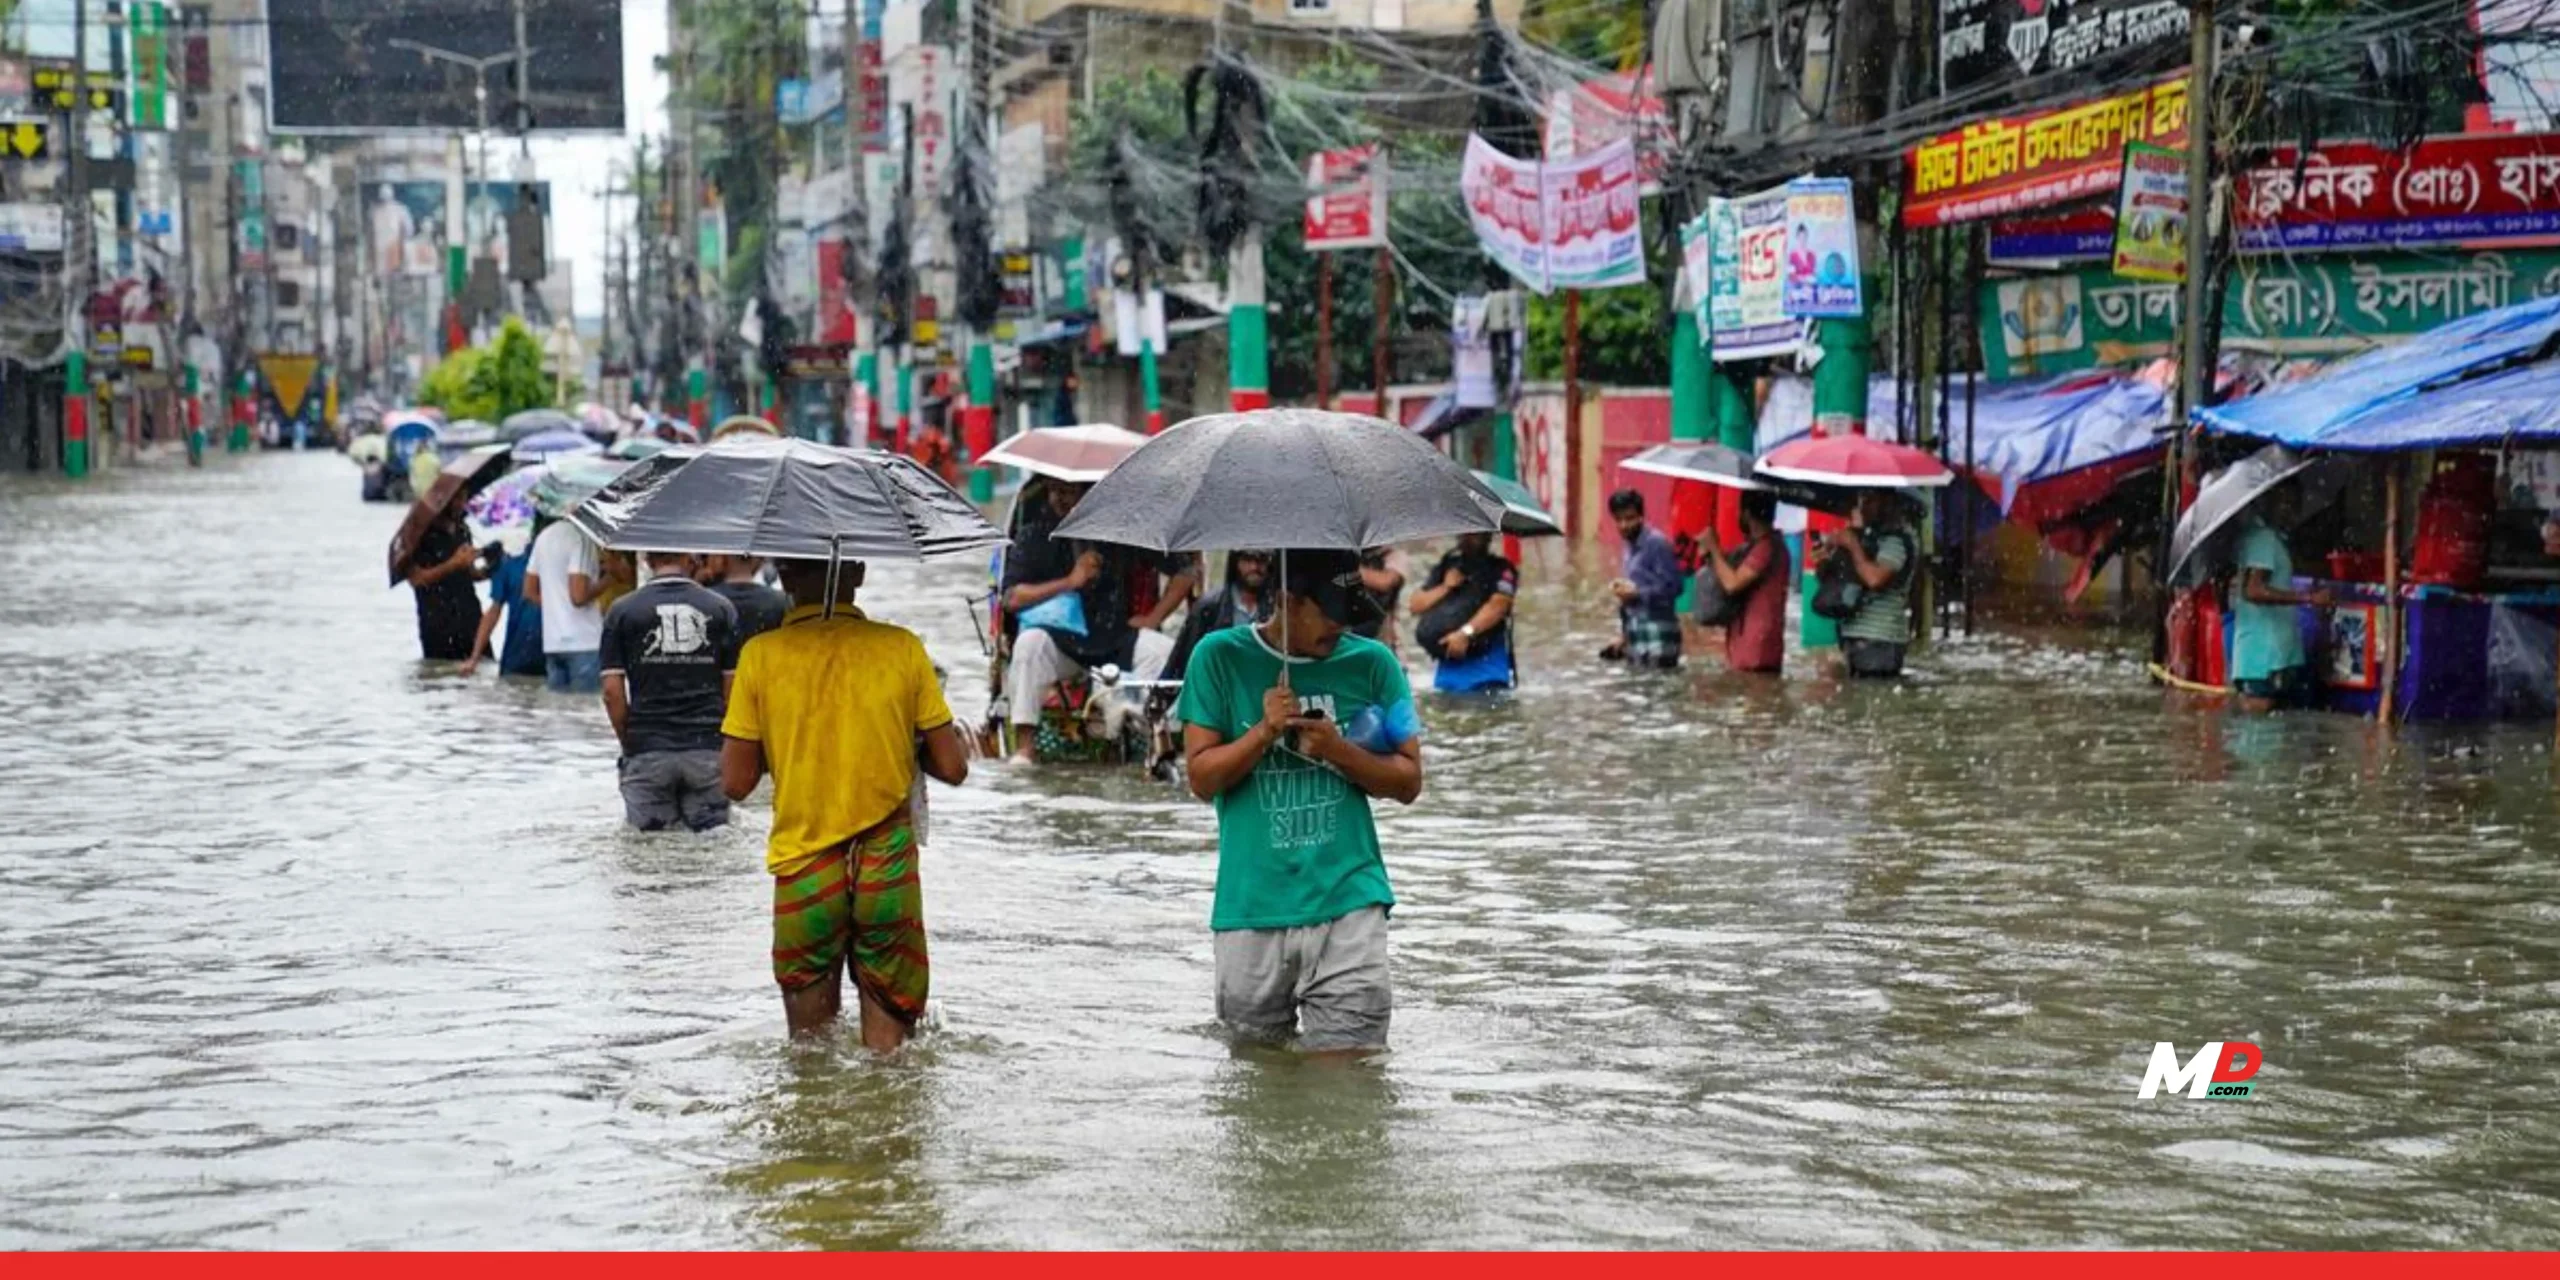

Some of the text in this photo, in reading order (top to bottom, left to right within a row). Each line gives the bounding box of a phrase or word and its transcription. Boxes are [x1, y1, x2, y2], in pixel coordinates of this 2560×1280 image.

[1915, 136, 1959, 194] মিড
[1962, 120, 2021, 185] টাউন
[2350, 251, 2516, 326] ইসলামী
[1256, 767, 1347, 812] WILD
[1269, 803, 1337, 841] SIDE
